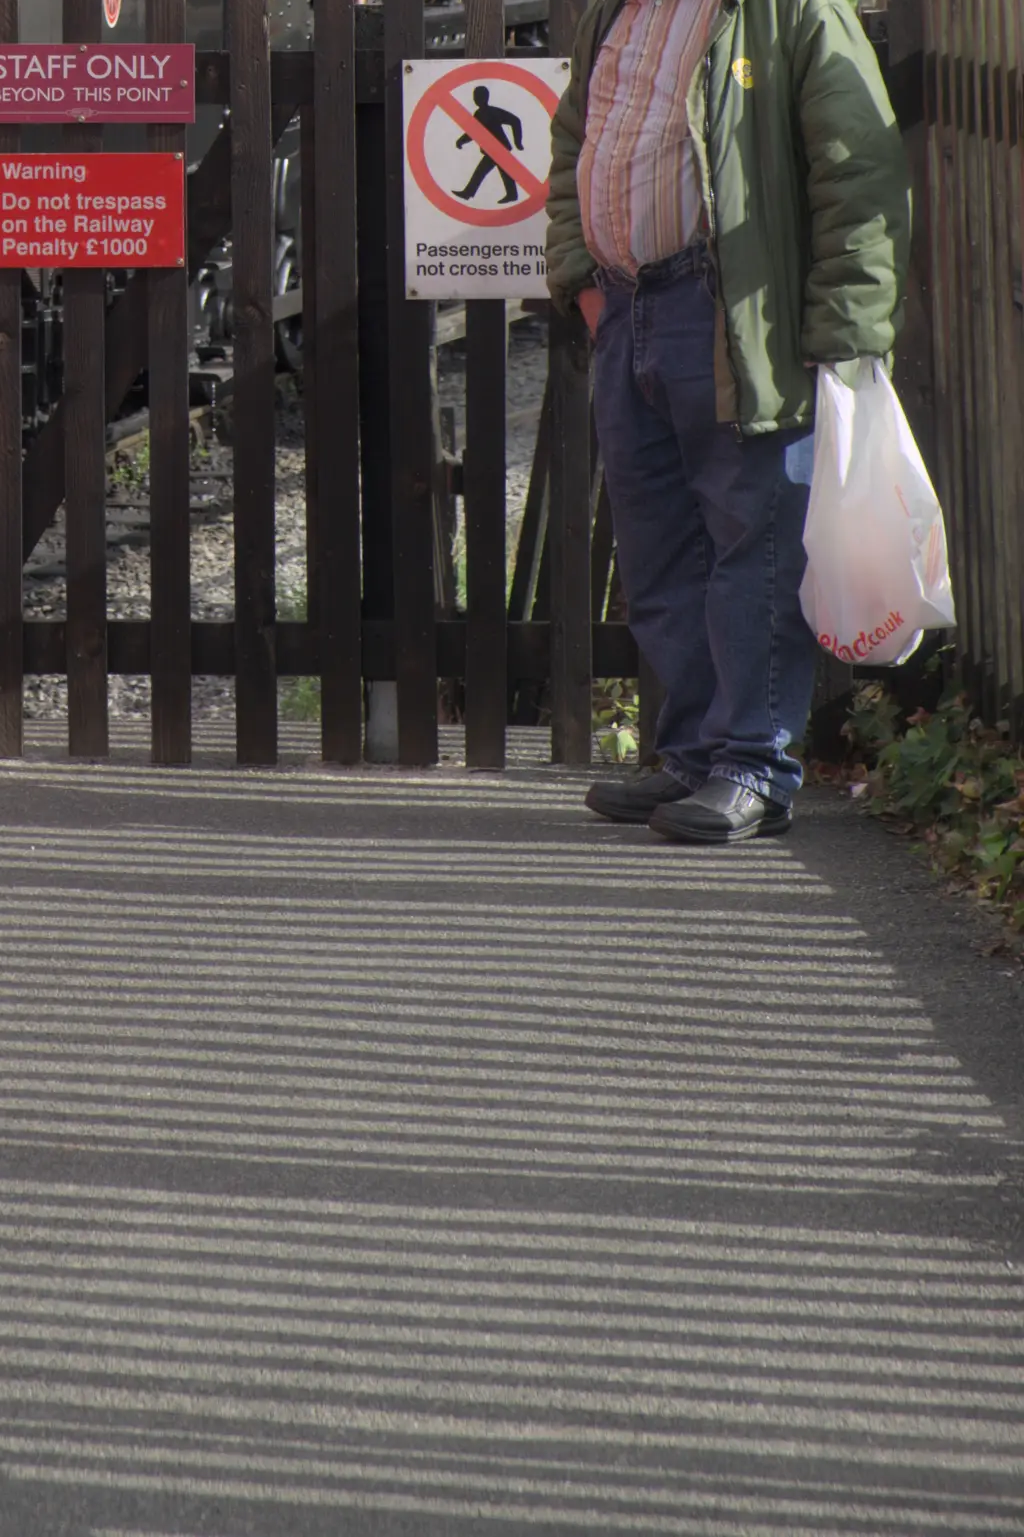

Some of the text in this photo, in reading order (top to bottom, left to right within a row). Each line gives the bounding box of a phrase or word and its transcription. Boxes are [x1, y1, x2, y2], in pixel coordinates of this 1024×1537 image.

[86, 54, 171, 80] ONLY
[73, 87, 112, 102] THIS
[117, 87, 172, 102] POINT
[2, 162, 86, 182] Warning
[2, 192, 167, 214] Do not trespass
[2, 215, 154, 237] on the Railway
[2, 238, 147, 260] Penalty £1000
[416, 242, 520, 260] Passengers
[416, 261, 549, 277] not cross the li
